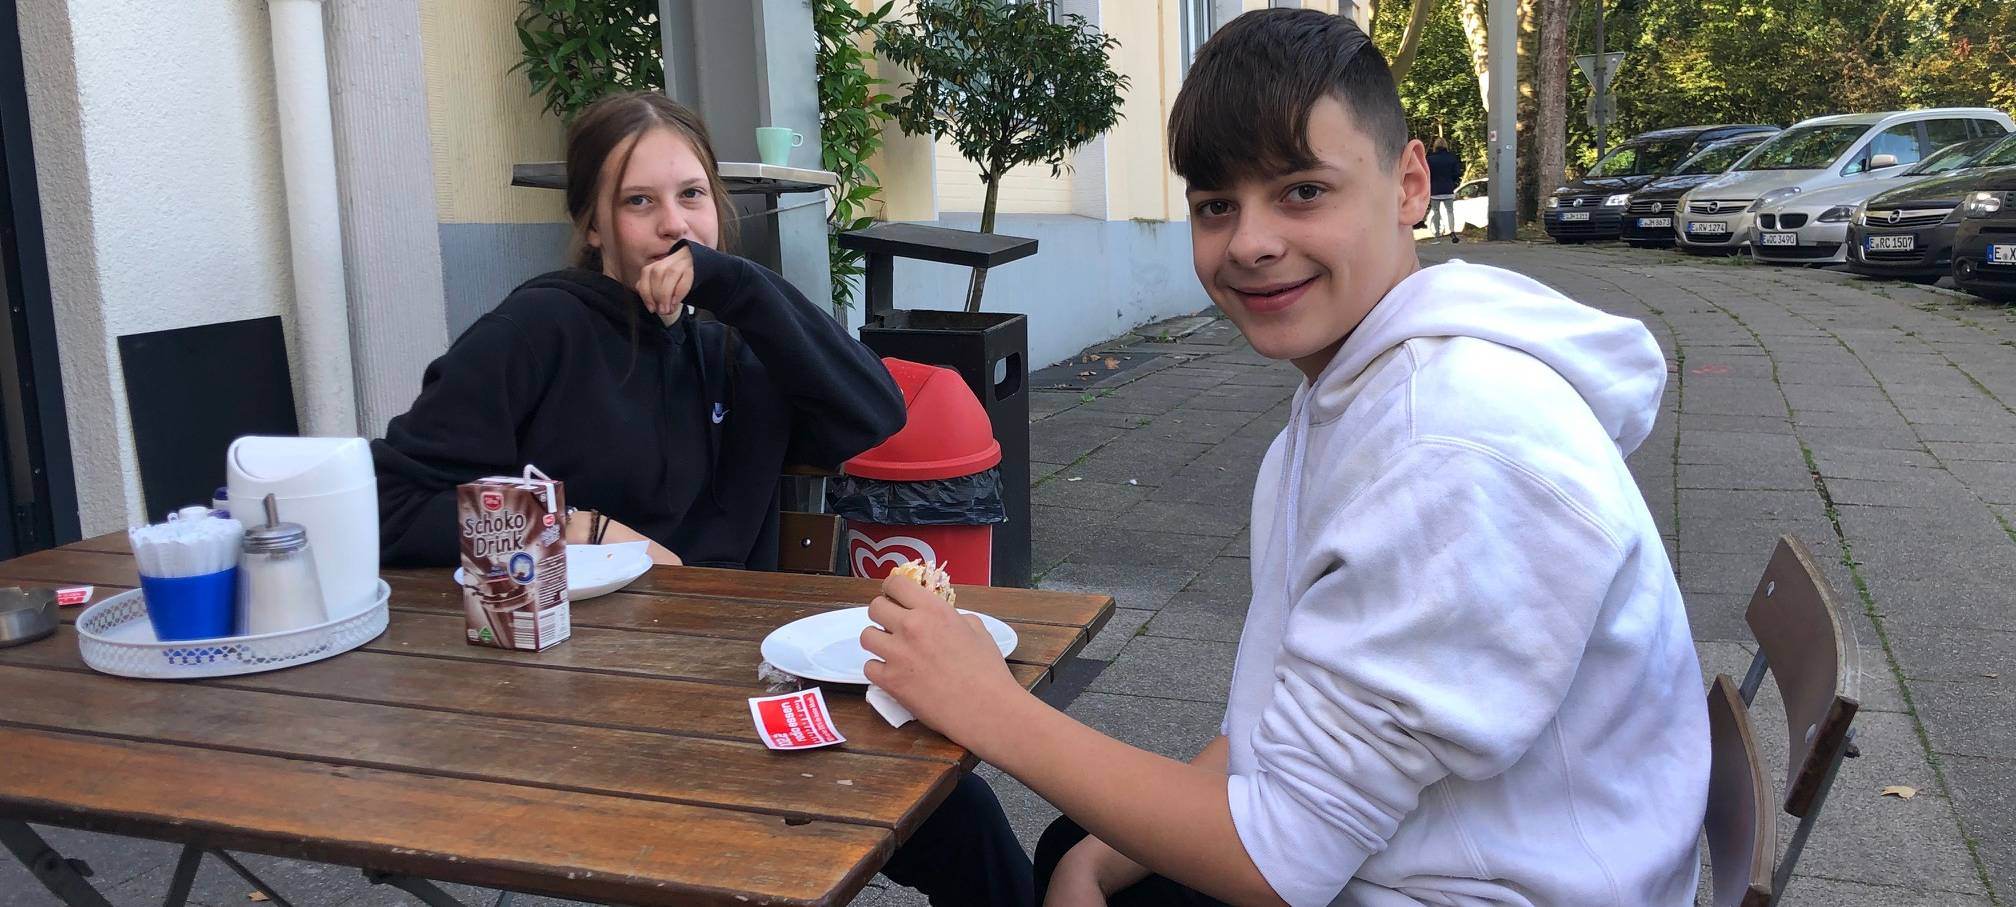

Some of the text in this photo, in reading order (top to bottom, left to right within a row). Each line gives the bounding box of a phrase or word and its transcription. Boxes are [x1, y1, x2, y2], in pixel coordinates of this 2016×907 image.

[1709, 223, 1725, 231] 1274
[1778, 234, 1795, 243] 3490
[1880, 237, 1890, 248] RC
[1892, 236, 1913, 248] 1507
[1995, 247, 2001, 260] E
[464, 510, 524, 536] Schoko
[476, 531, 523, 556] Drink
